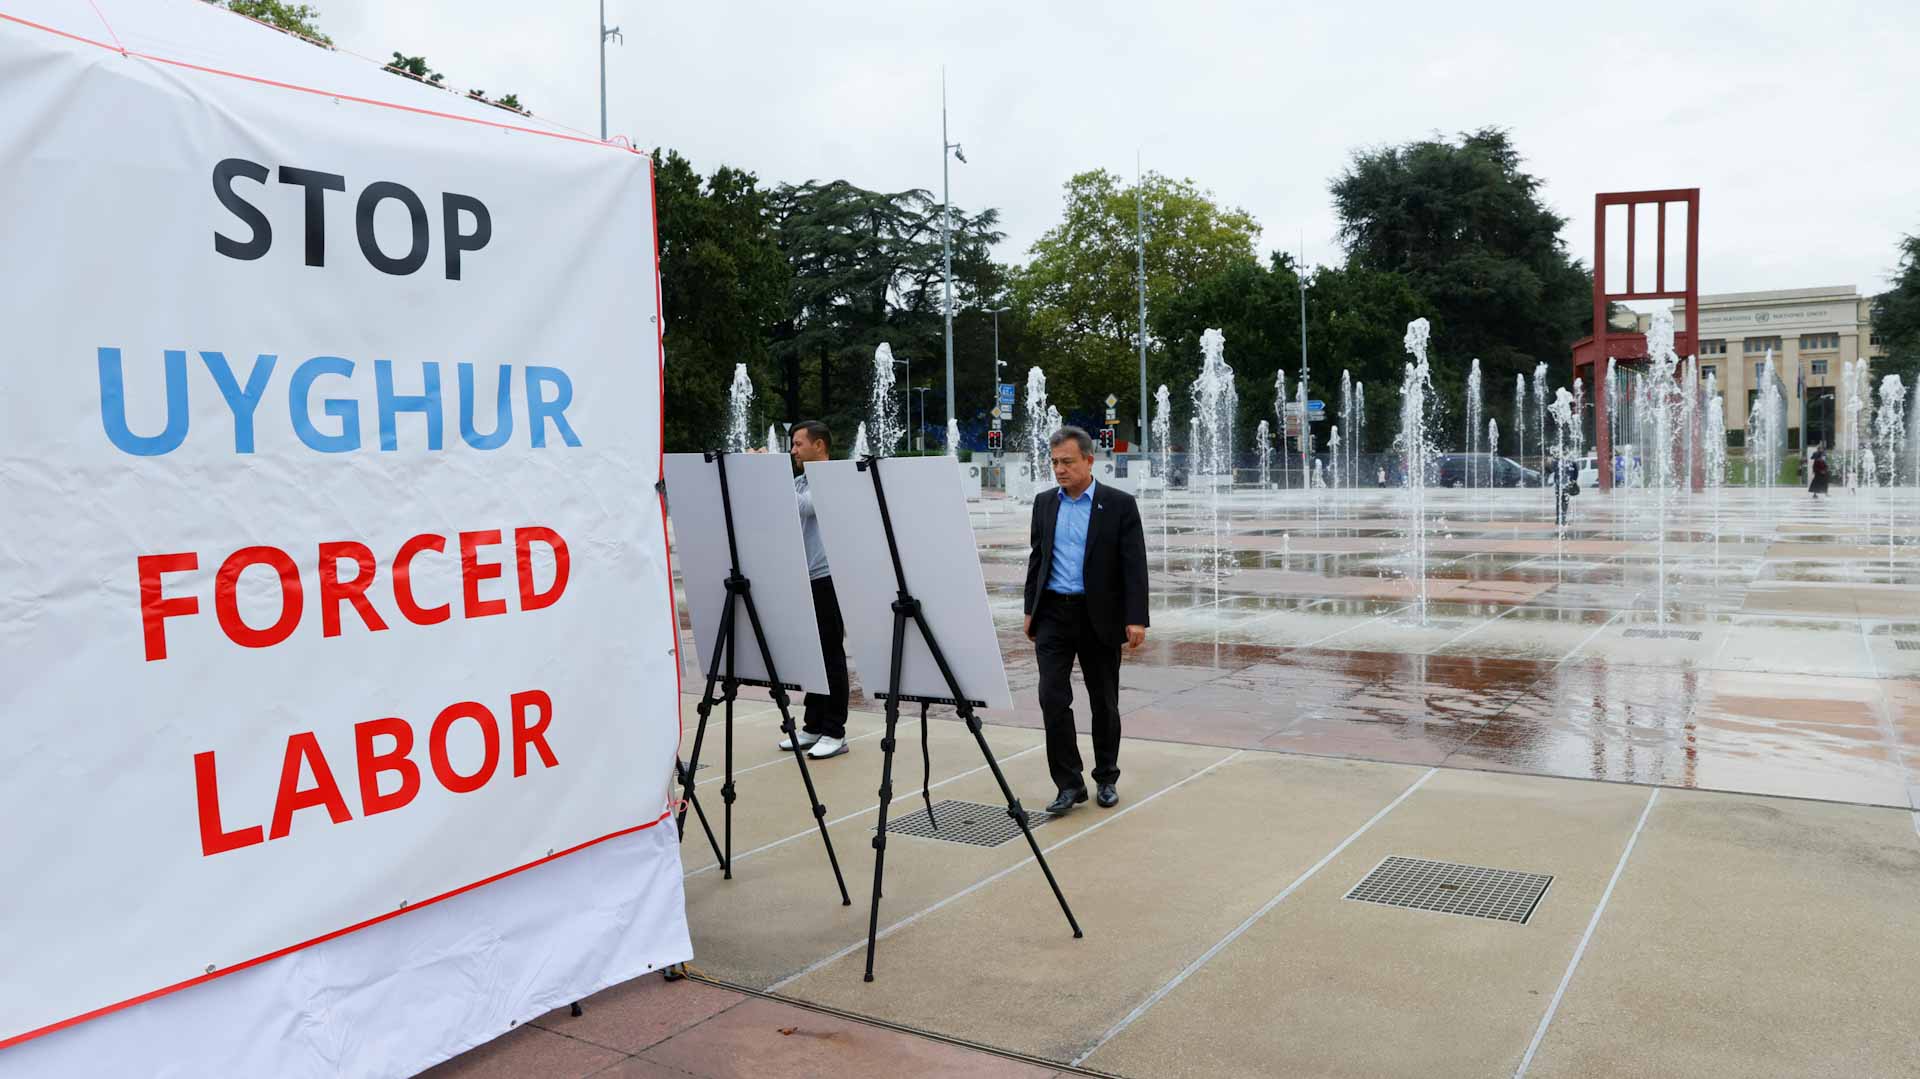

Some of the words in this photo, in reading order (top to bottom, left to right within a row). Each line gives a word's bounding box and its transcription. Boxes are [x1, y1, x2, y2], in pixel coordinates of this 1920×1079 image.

[213, 158, 492, 281] STOP
[97, 345, 583, 458] UYGHUR
[137, 526, 571, 662] FORCED
[194, 689, 560, 857] LABOR
